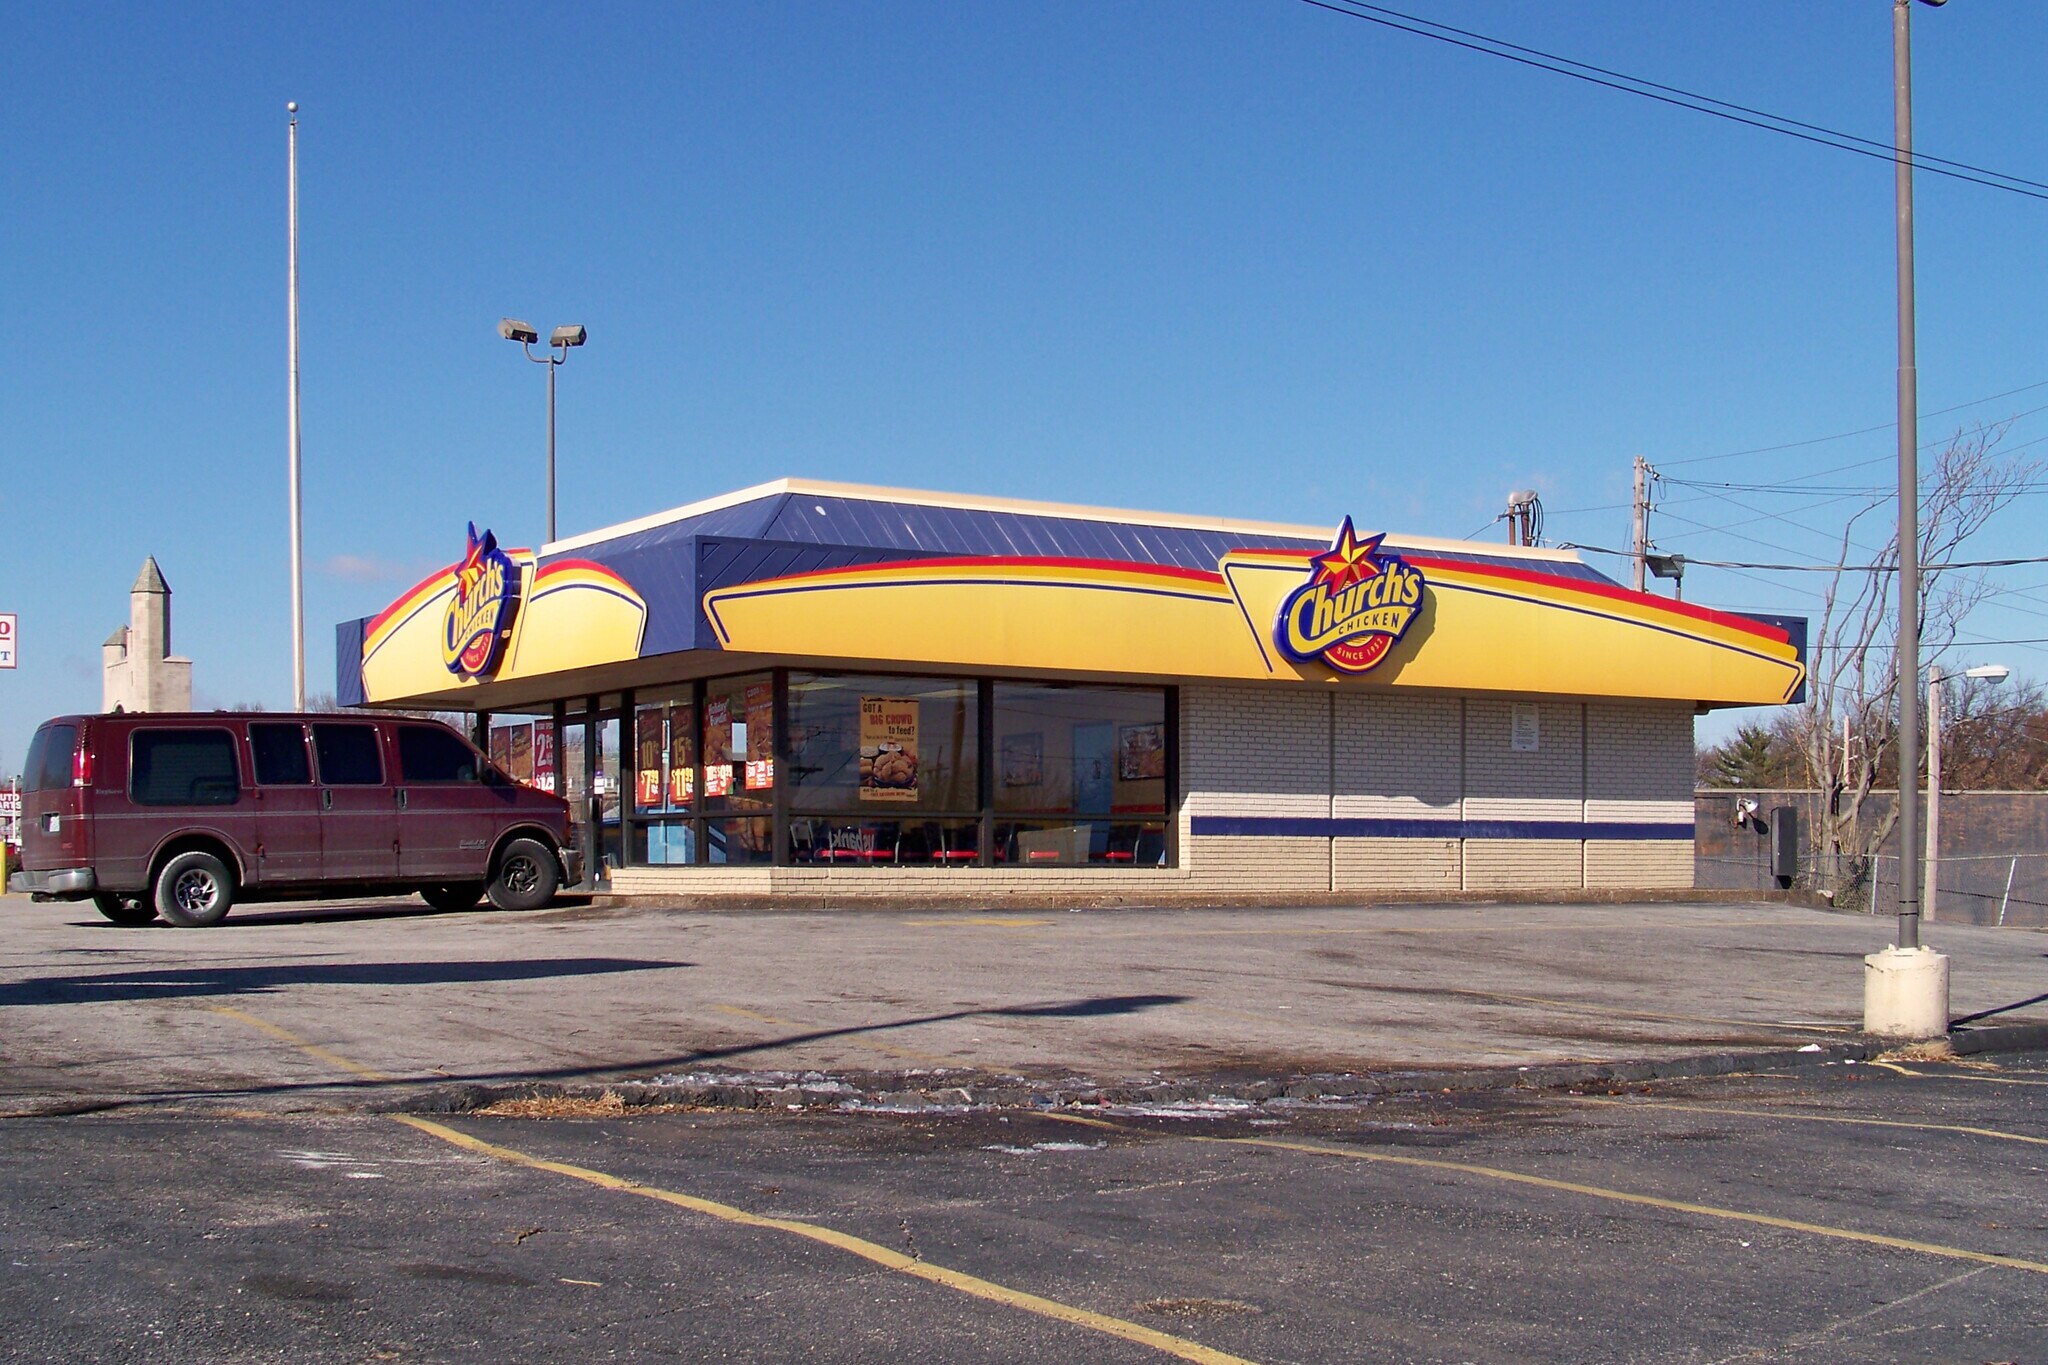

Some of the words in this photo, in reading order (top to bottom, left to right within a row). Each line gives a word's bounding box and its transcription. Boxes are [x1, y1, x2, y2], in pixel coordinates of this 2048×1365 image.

[442, 557, 504, 665] Church's
[1288, 563, 1420, 654] Church's
[465, 607, 496, 640] CHICKEN
[1338, 612, 1400, 634] CHICKEN
[1336, 646, 1364, 660] SINCE
[1366, 637, 1383, 656] 1952
[863, 703, 876, 713] GOT
[878, 704, 882, 713] A
[870, 714, 883, 726] BIG
[886, 714, 913, 725] CROWD
[888, 726, 896, 735] to
[897, 726, 915, 735] feed?
